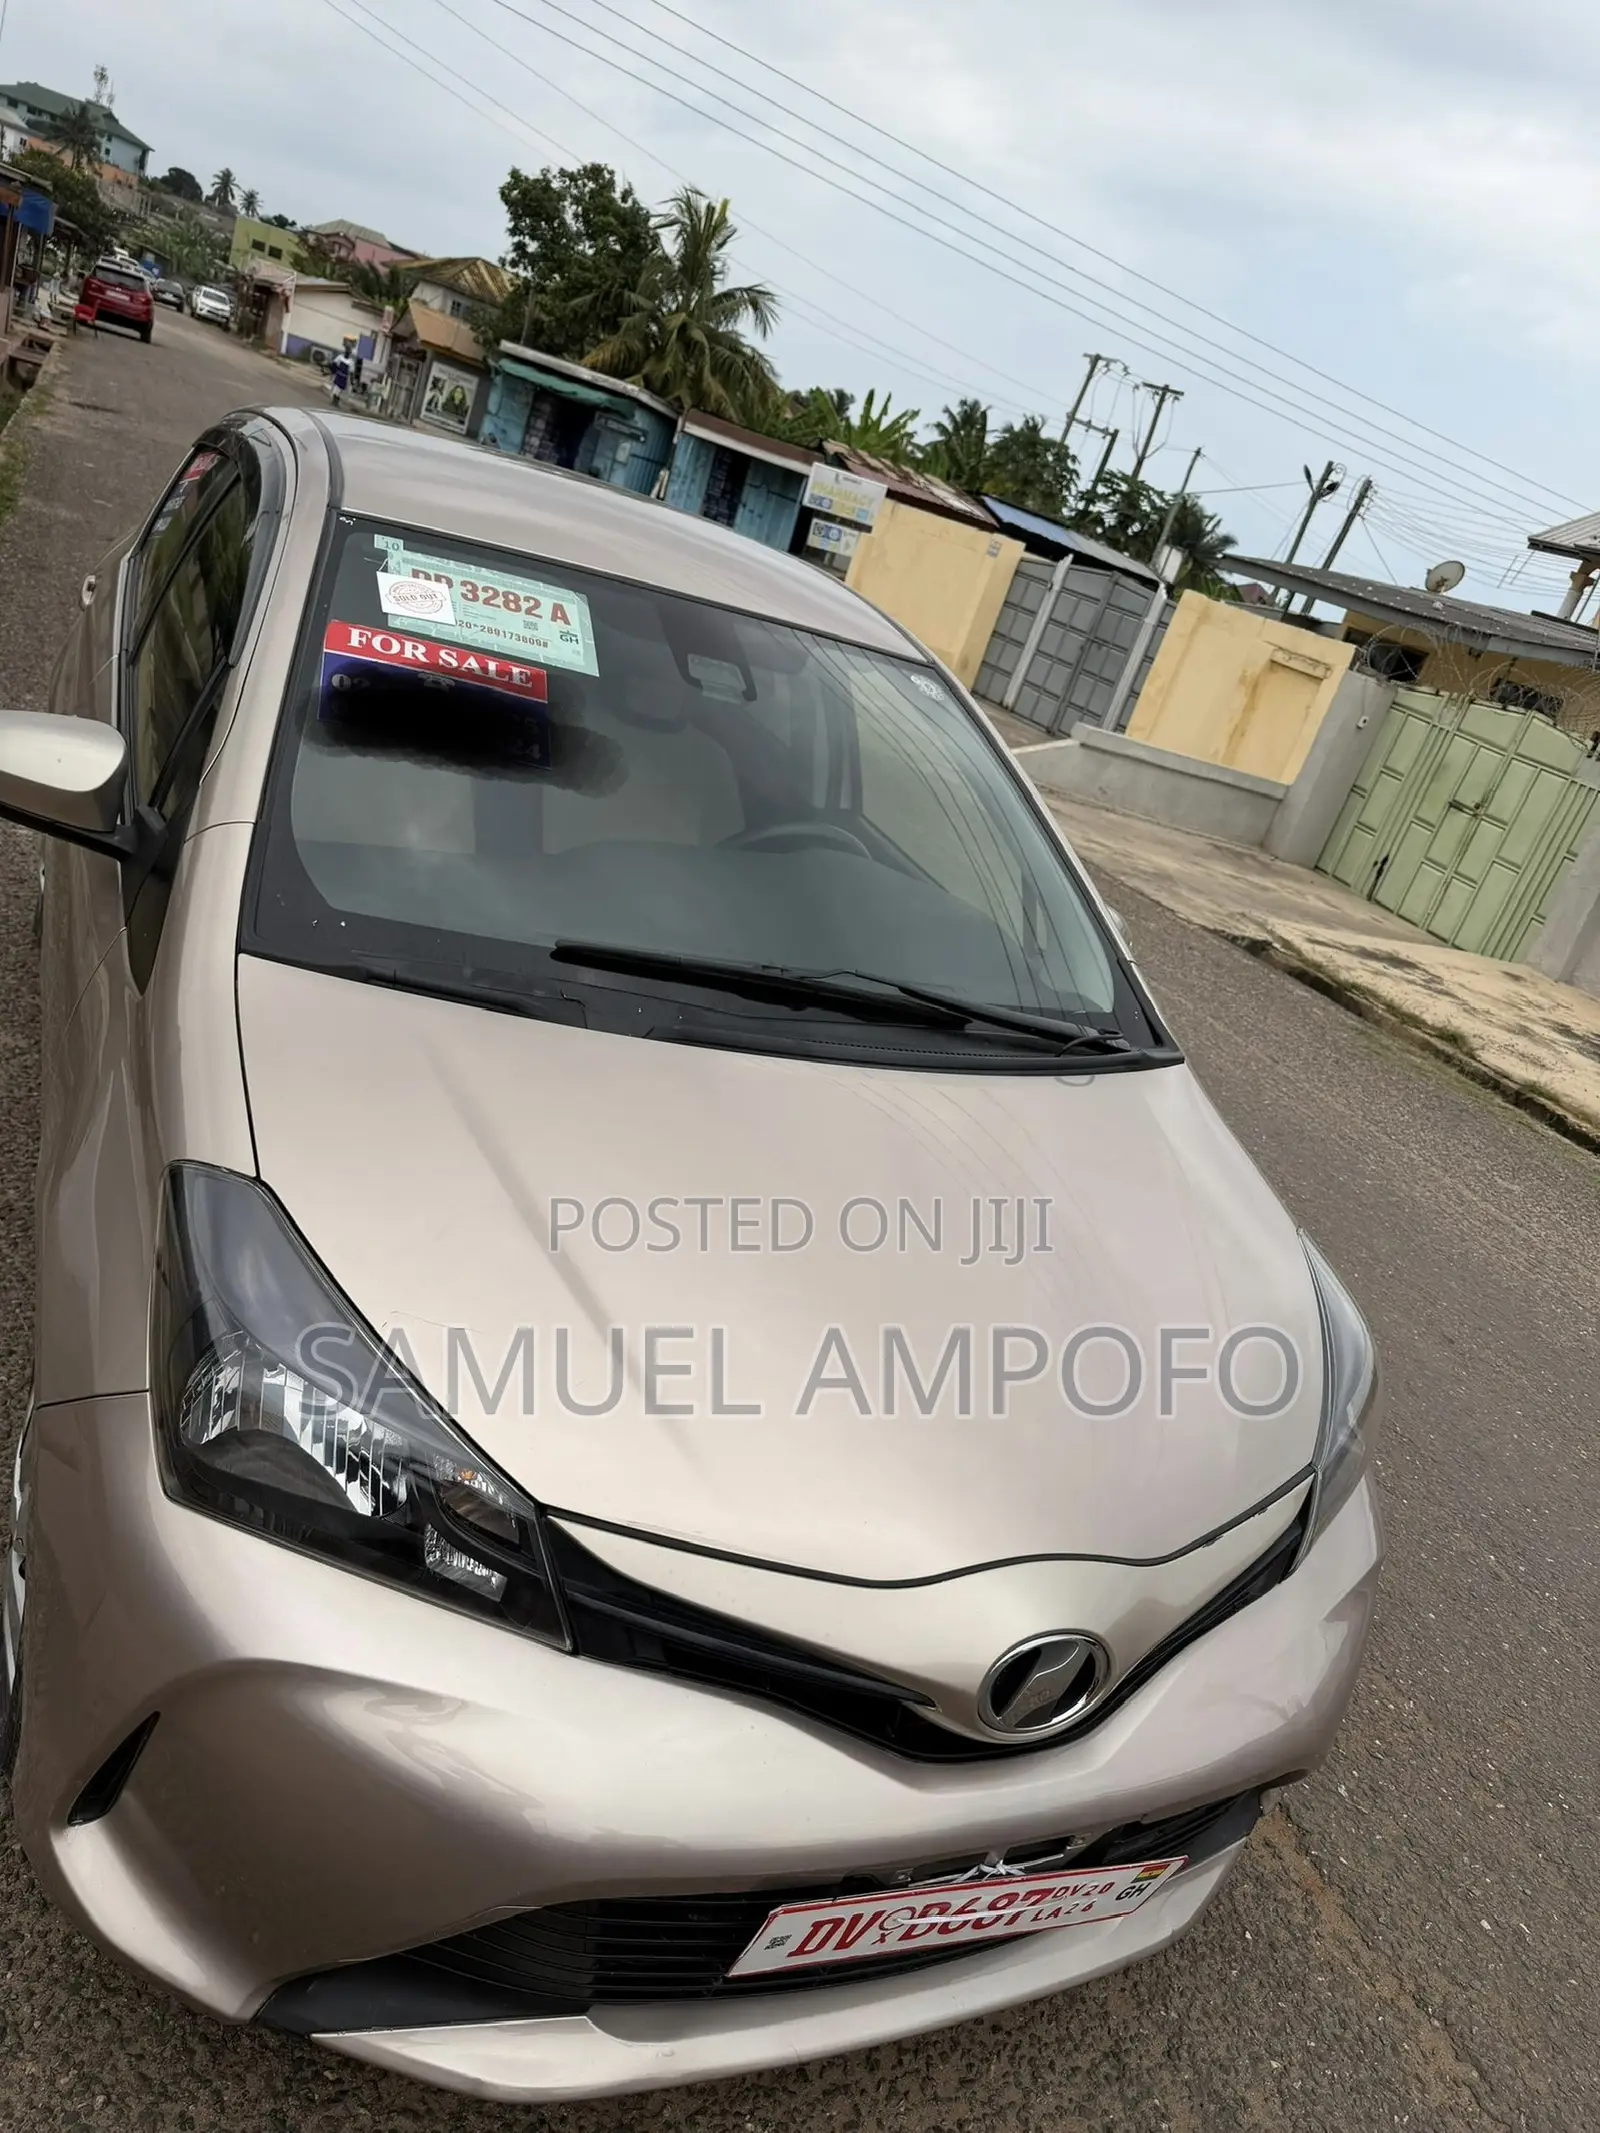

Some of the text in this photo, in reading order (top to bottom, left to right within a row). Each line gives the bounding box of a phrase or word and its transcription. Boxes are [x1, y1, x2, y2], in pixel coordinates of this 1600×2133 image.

[460, 579, 543, 619] 3282
[550, 602, 572, 626] A
[559, 633, 580, 645] GH
[347, 627, 533, 688] FOR SALE
[1051, 1881, 1116, 1899] DV20
[1115, 1882, 1152, 1901] GH
[1030, 1900, 1097, 1922] LA26
[786, 1909, 887, 1958] DV
